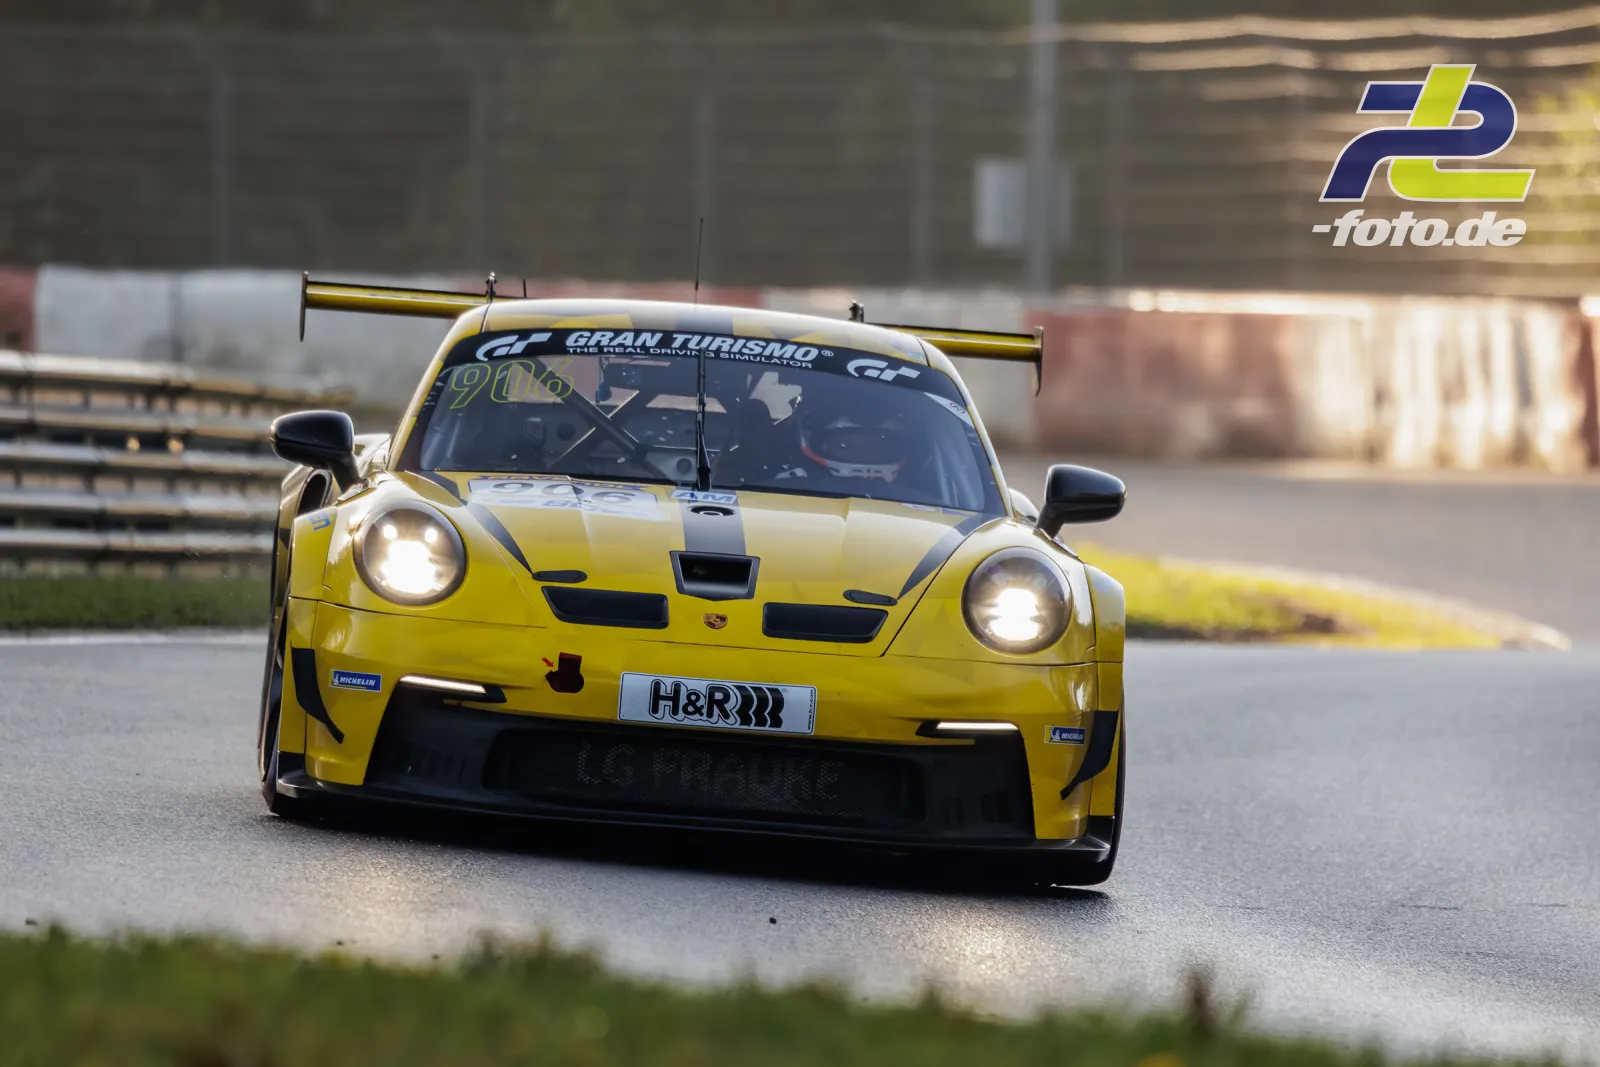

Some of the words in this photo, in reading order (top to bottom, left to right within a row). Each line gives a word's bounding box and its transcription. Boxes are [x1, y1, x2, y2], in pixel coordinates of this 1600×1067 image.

[565, 331, 663, 347] GRAN
[720, 352, 812, 369] SIMULATOR
[450, 359, 574, 409] 906
[489, 482, 636, 503] 906
[675, 491, 734, 503] AM
[340, 676, 376, 686] MICHELIN
[649, 679, 739, 725] H&R
